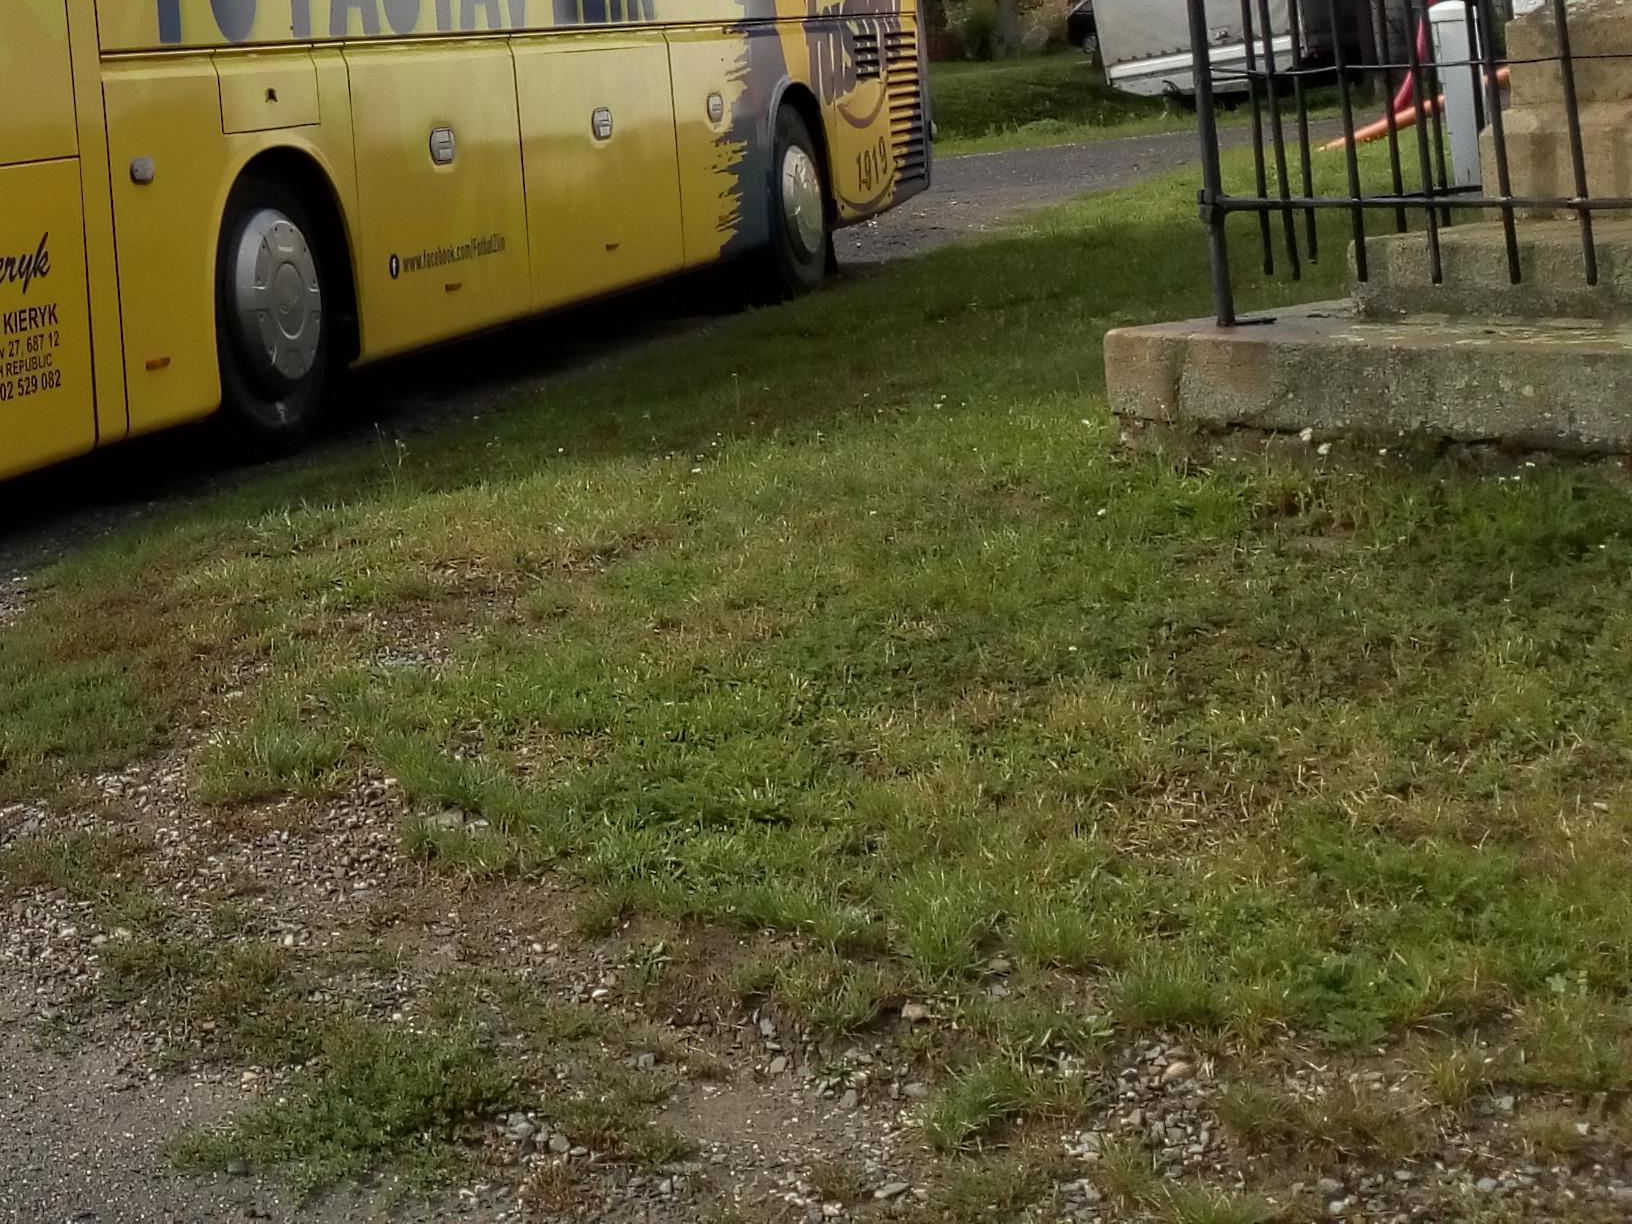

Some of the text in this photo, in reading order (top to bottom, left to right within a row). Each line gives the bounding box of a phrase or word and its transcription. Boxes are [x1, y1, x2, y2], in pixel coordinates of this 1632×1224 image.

[856, 136, 888, 193] 1919
[3, 303, 59, 335] KIERYK
[26, 334, 45, 354] 687
[48, 331, 60, 348] 12
[6, 353, 53, 378] REPUBLIC
[18, 374, 38, 398] 529
[41, 369, 62, 392] 082
